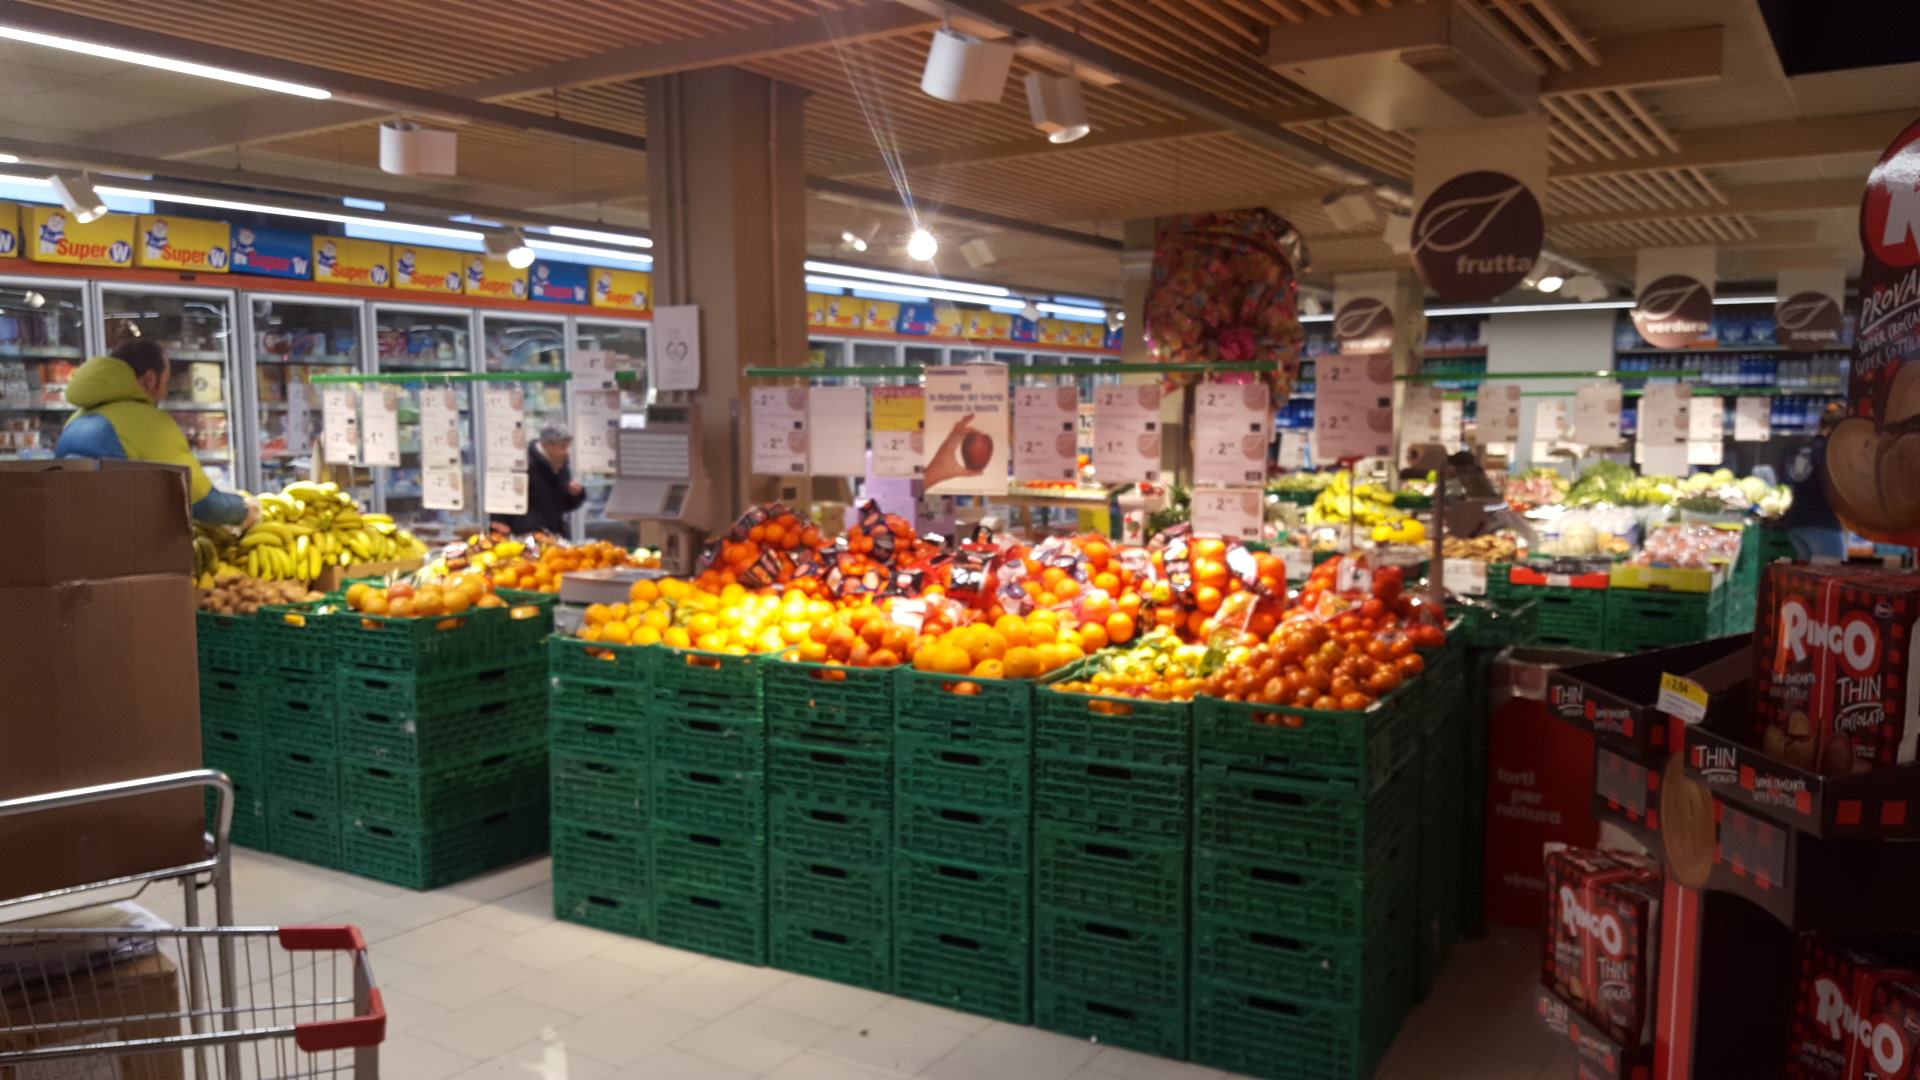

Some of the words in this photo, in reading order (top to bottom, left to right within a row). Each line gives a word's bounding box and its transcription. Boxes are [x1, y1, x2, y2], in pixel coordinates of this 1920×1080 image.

[57, 238, 108, 260] Super
[112, 243, 131, 262] W
[162, 244, 206, 265] Super
[209, 248, 227, 267] W
[332, 262, 370, 280] Super
[1456, 254, 1532, 275] frutta
[411, 270, 446, 288] Super
[1647, 320, 1708, 333] verdura
[1782, 602, 1876, 671] RINGO
[1552, 684, 1583, 704] THIN
[1836, 674, 1882, 706] THIN
[1695, 745, 1736, 768] THIN
[1497, 767, 1535, 787] forti
[1511, 789, 1544, 806] per
[1495, 803, 1561, 825] natura
[1560, 886, 1623, 955] RINGO
[1598, 957, 1628, 980] THIN
[1814, 978, 1904, 1074] RINGO
